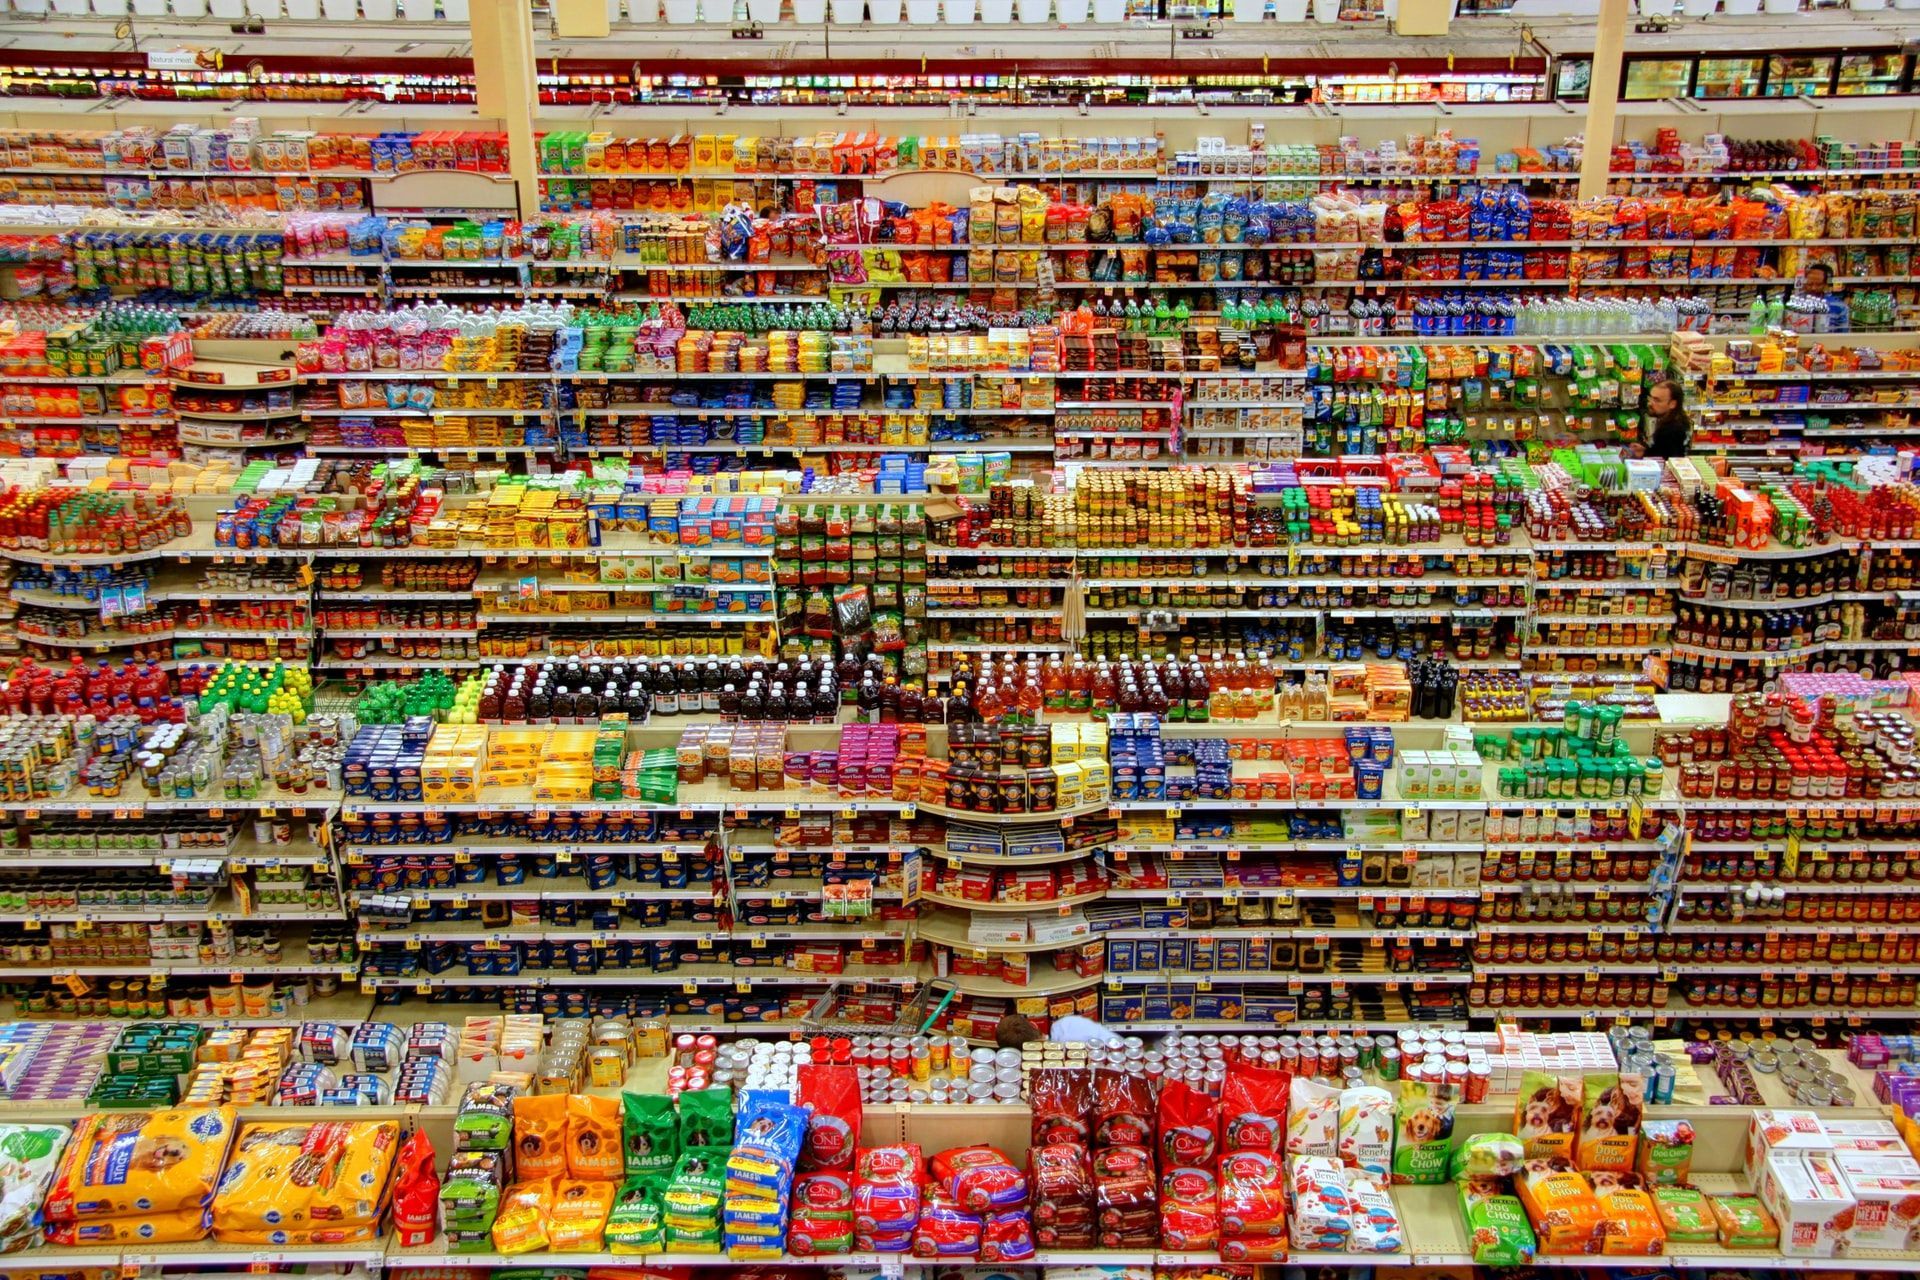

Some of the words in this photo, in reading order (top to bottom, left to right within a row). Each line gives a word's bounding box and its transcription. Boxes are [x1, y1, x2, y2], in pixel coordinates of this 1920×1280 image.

[812, 1135, 840, 1146] ONE
[1109, 1130, 1137, 1141] ONE
[1240, 1130, 1270, 1142] ONE
[740, 1136, 772, 1147] IAMS
[1412, 1152, 1434, 1160] DOG
[1596, 1147, 1617, 1156] DOG
[628, 1157, 660, 1165] IAMS
[872, 1158, 900, 1167] ONE
[1410, 1158, 1443, 1168] CHOW
[118, 1151, 128, 1182] ADULT
[1234, 1162, 1262, 1172] ONE
[1547, 1180, 1568, 1189] DOG
[1486, 1204, 1509, 1212] DOG
[1487, 1211, 1520, 1221] CHOW
[1856, 1210, 1888, 1220] MEATY
